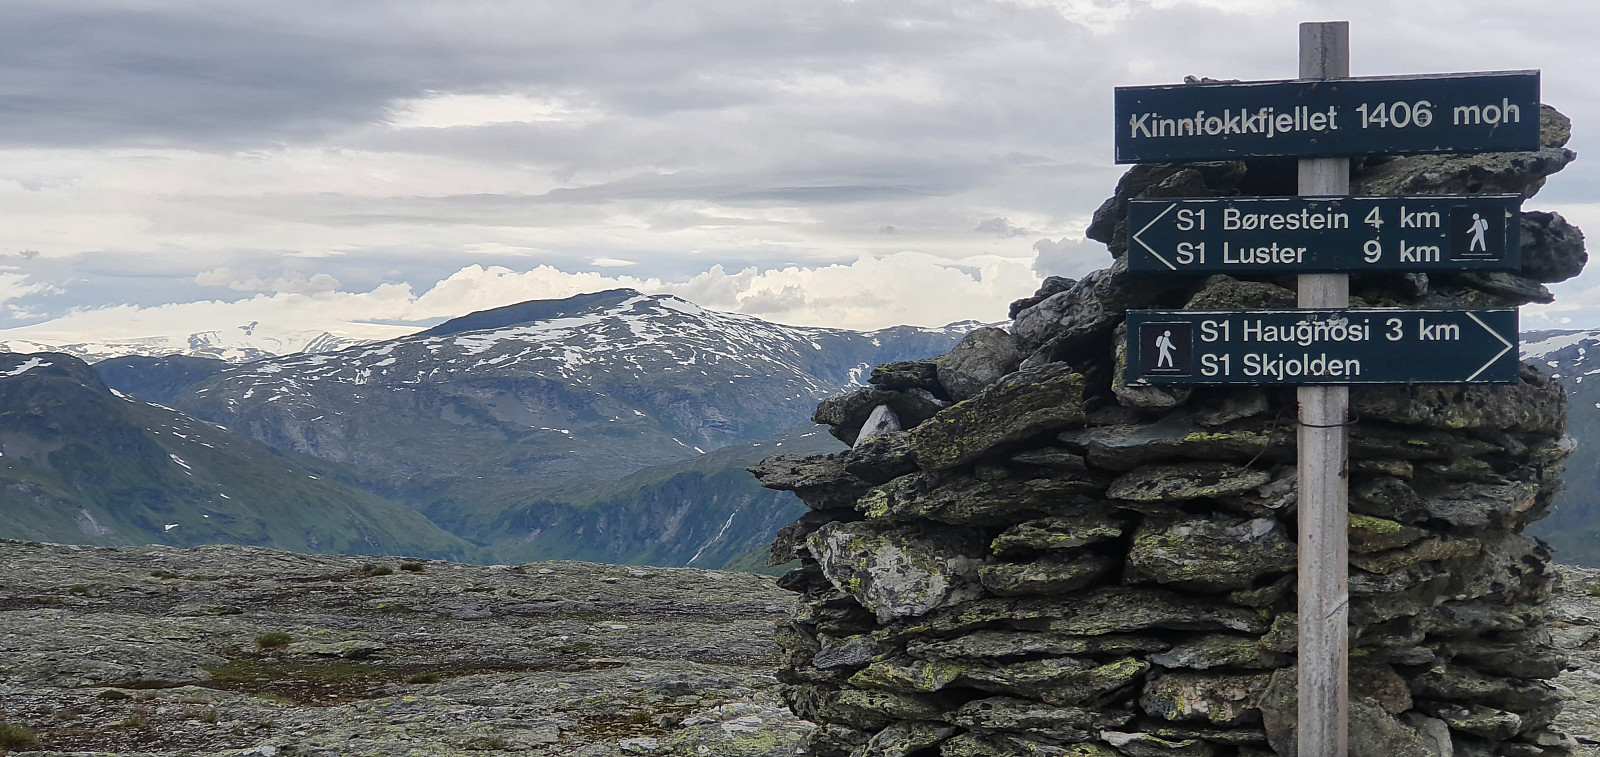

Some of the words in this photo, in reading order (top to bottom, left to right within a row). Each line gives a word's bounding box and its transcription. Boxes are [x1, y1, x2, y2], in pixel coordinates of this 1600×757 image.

[1130, 104, 1338, 138] Kinnfokkfjellet
[1356, 100, 1433, 129] 1406
[1453, 98, 1520, 125] moh
[1176, 208, 1206, 231] S1
[1223, 207, 1349, 230] Børestein
[1363, 207, 1383, 230] 4
[1400, 206, 1440, 228] km
[1176, 242, 1206, 264] S1
[1223, 241, 1307, 264] Luster
[1363, 240, 1382, 263] 9
[1400, 241, 1440, 262] km
[1200, 320, 1230, 342] S1
[1243, 318, 1370, 346] Haugnosi
[1385, 318, 1403, 341] 3
[1419, 318, 1460, 341] km
[1200, 353, 1230, 376] S1
[1243, 353, 1360, 380] Skjolden
